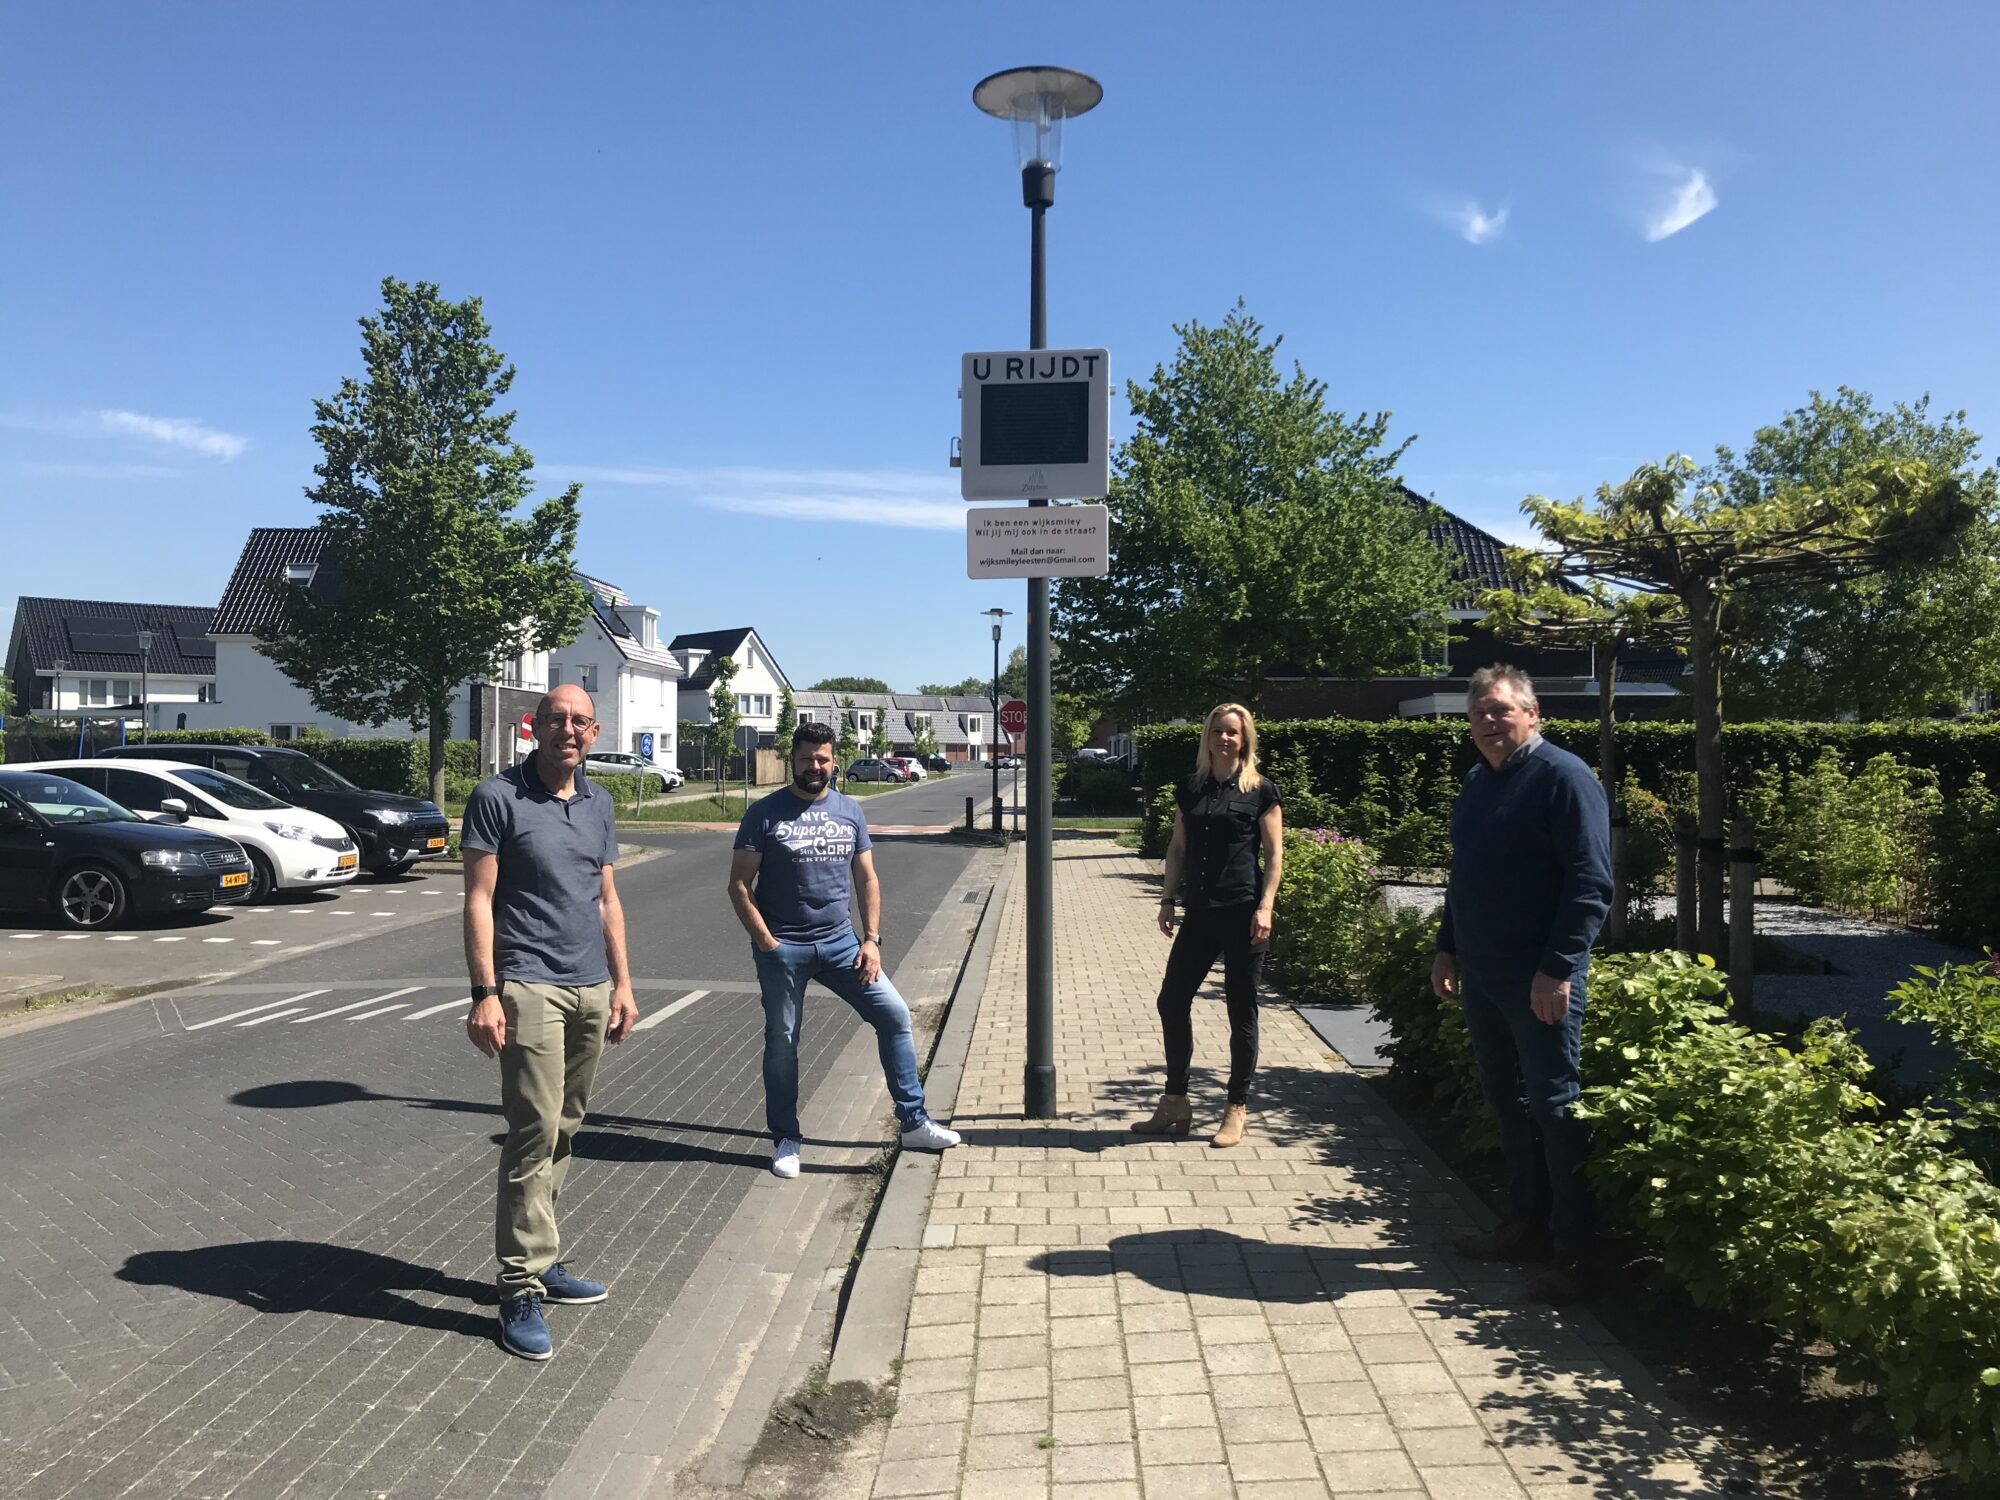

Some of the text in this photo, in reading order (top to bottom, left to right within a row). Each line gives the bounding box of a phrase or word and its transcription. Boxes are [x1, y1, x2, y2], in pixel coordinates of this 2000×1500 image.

[973, 355, 1100, 380] U RIJDT
[983, 519, 992, 527] Ik
[994, 519, 1010, 527] ben
[1032, 518, 1081, 527] wijksmiley
[975, 529, 989, 537] Wil
[991, 528, 1001, 538] jij
[1004, 528, 1019, 537] mij
[1021, 528, 1037, 536] ook
[1051, 527, 1062, 535] de
[1064, 526, 1097, 535] straat?
[1030, 547, 1044, 555] dan
[801, 811, 829, 821] NYC
